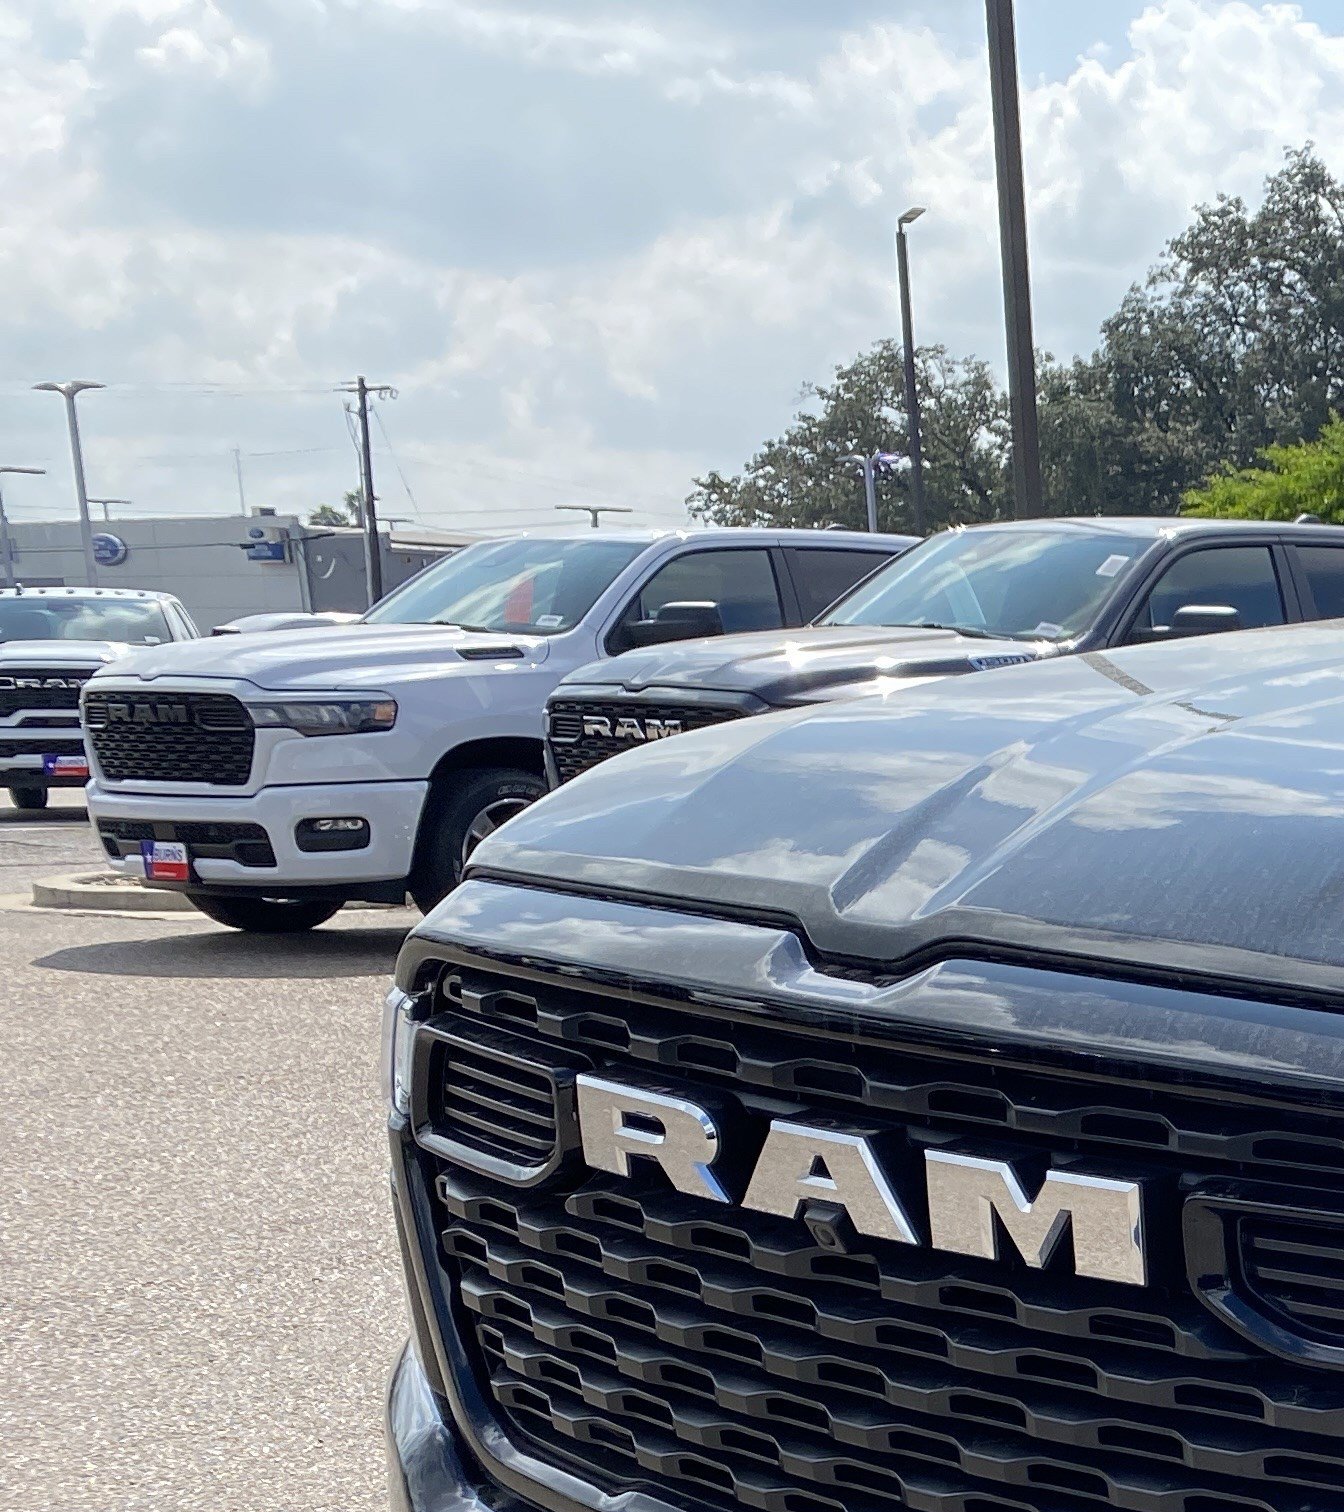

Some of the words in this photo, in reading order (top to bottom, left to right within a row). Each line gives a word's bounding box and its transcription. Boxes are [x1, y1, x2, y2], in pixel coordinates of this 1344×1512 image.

[109, 703, 188, 723] RAM
[582, 715, 683, 740] RAM
[575, 1073, 1149, 1287] RAM
